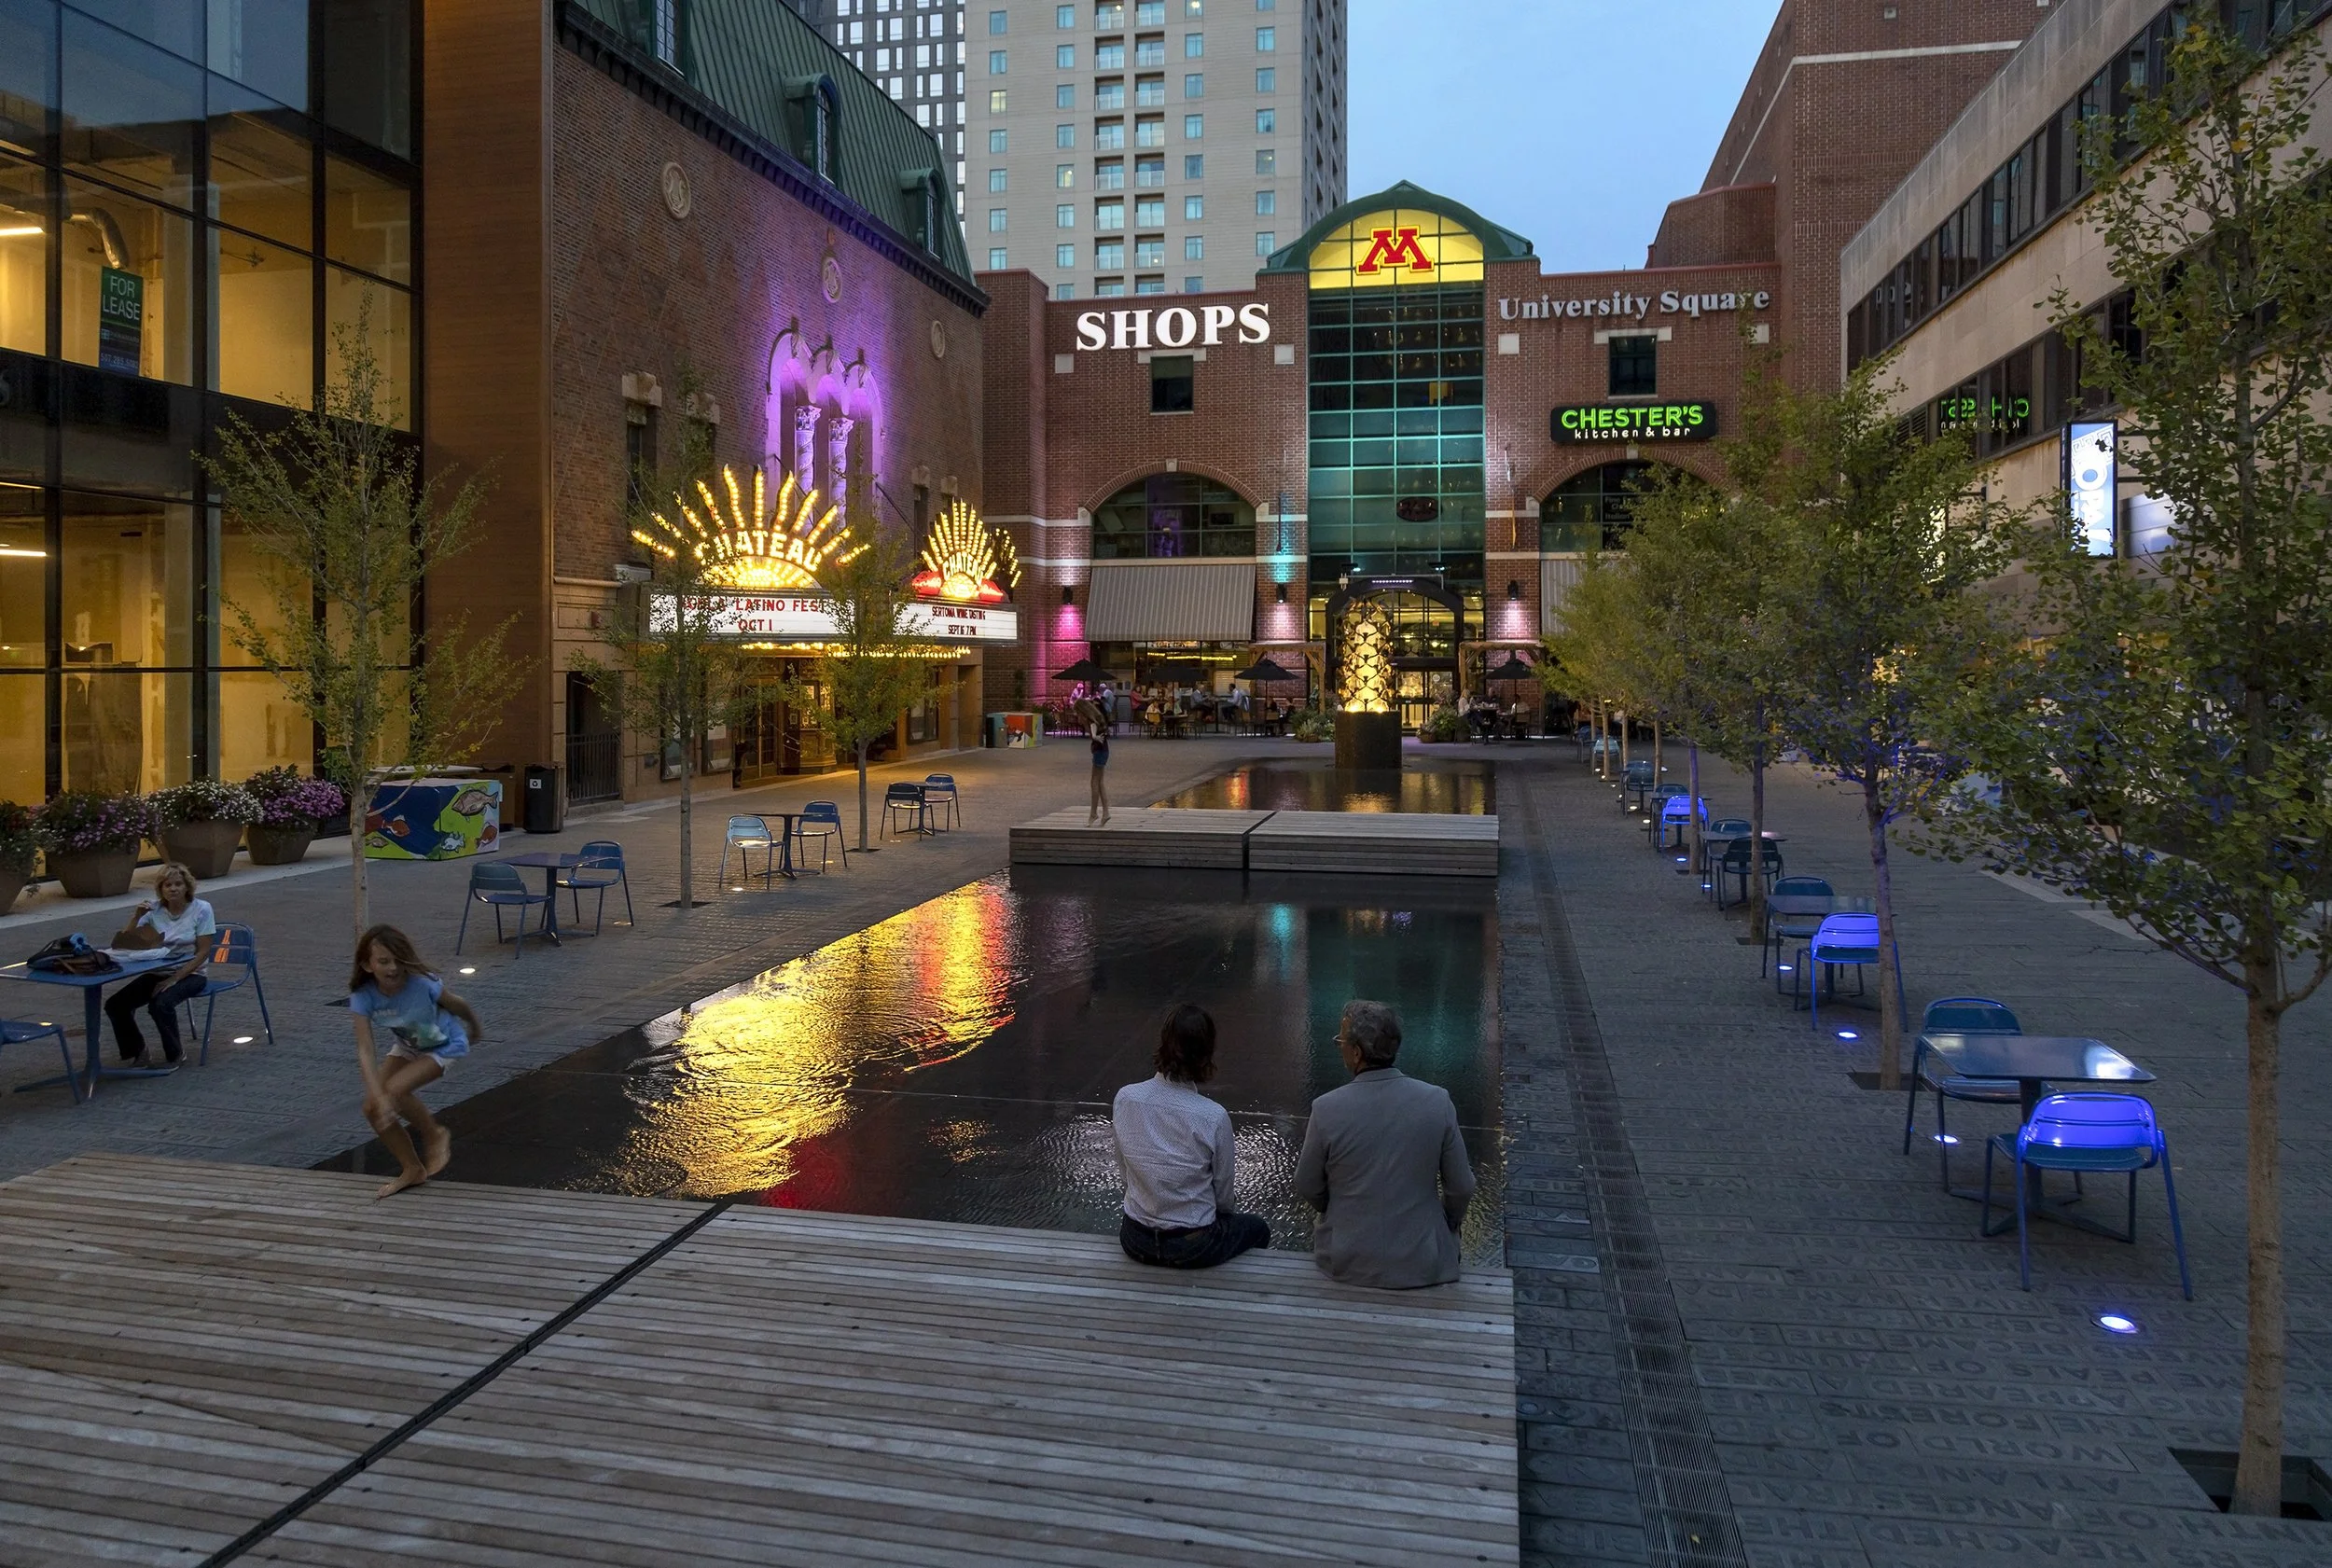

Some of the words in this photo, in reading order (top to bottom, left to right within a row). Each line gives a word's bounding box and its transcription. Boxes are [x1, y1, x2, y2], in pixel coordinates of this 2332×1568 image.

[1356, 226, 1435, 275] M
[110, 275, 135, 298] FOR
[103, 294, 141, 321] LEASE
[1498, 290, 1651, 320] University
[1659, 290, 1770, 318] Square
[1076, 303, 1270, 351] SHOPS
[1562, 405, 1703, 429] CHESTER'S
[1575, 427, 1639, 439] kitchen
[1645, 426, 1655, 437] &
[1662, 426, 1691, 437] bar
[942, 550, 985, 587] CHATEAU
[735, 599, 785, 612] LATINO
[932, 606, 955, 617] SERTOMA
[956, 608, 968, 618] WINE
[737, 618, 765, 631] OCT
[948, 624, 960, 634] SEPT
[1920, 1357, 1991, 1375] OF
[2004, 1361, 2160, 1386] PEALS
[1866, 1377, 2133, 1409] APPEARED
[1828, 1427, 1904, 1450] OF
[2050, 1416, 2158, 1438] THE
[1723, 1449, 1839, 1474] AND
[1917, 1434, 2125, 1465] WORLD
[1729, 1477, 2064, 1524] ANCESTRAL
[1739, 1513, 1843, 1541] THE
[2070, 1506, 2163, 1531] OF
[1864, 1519, 2151, 1564] REACHED
